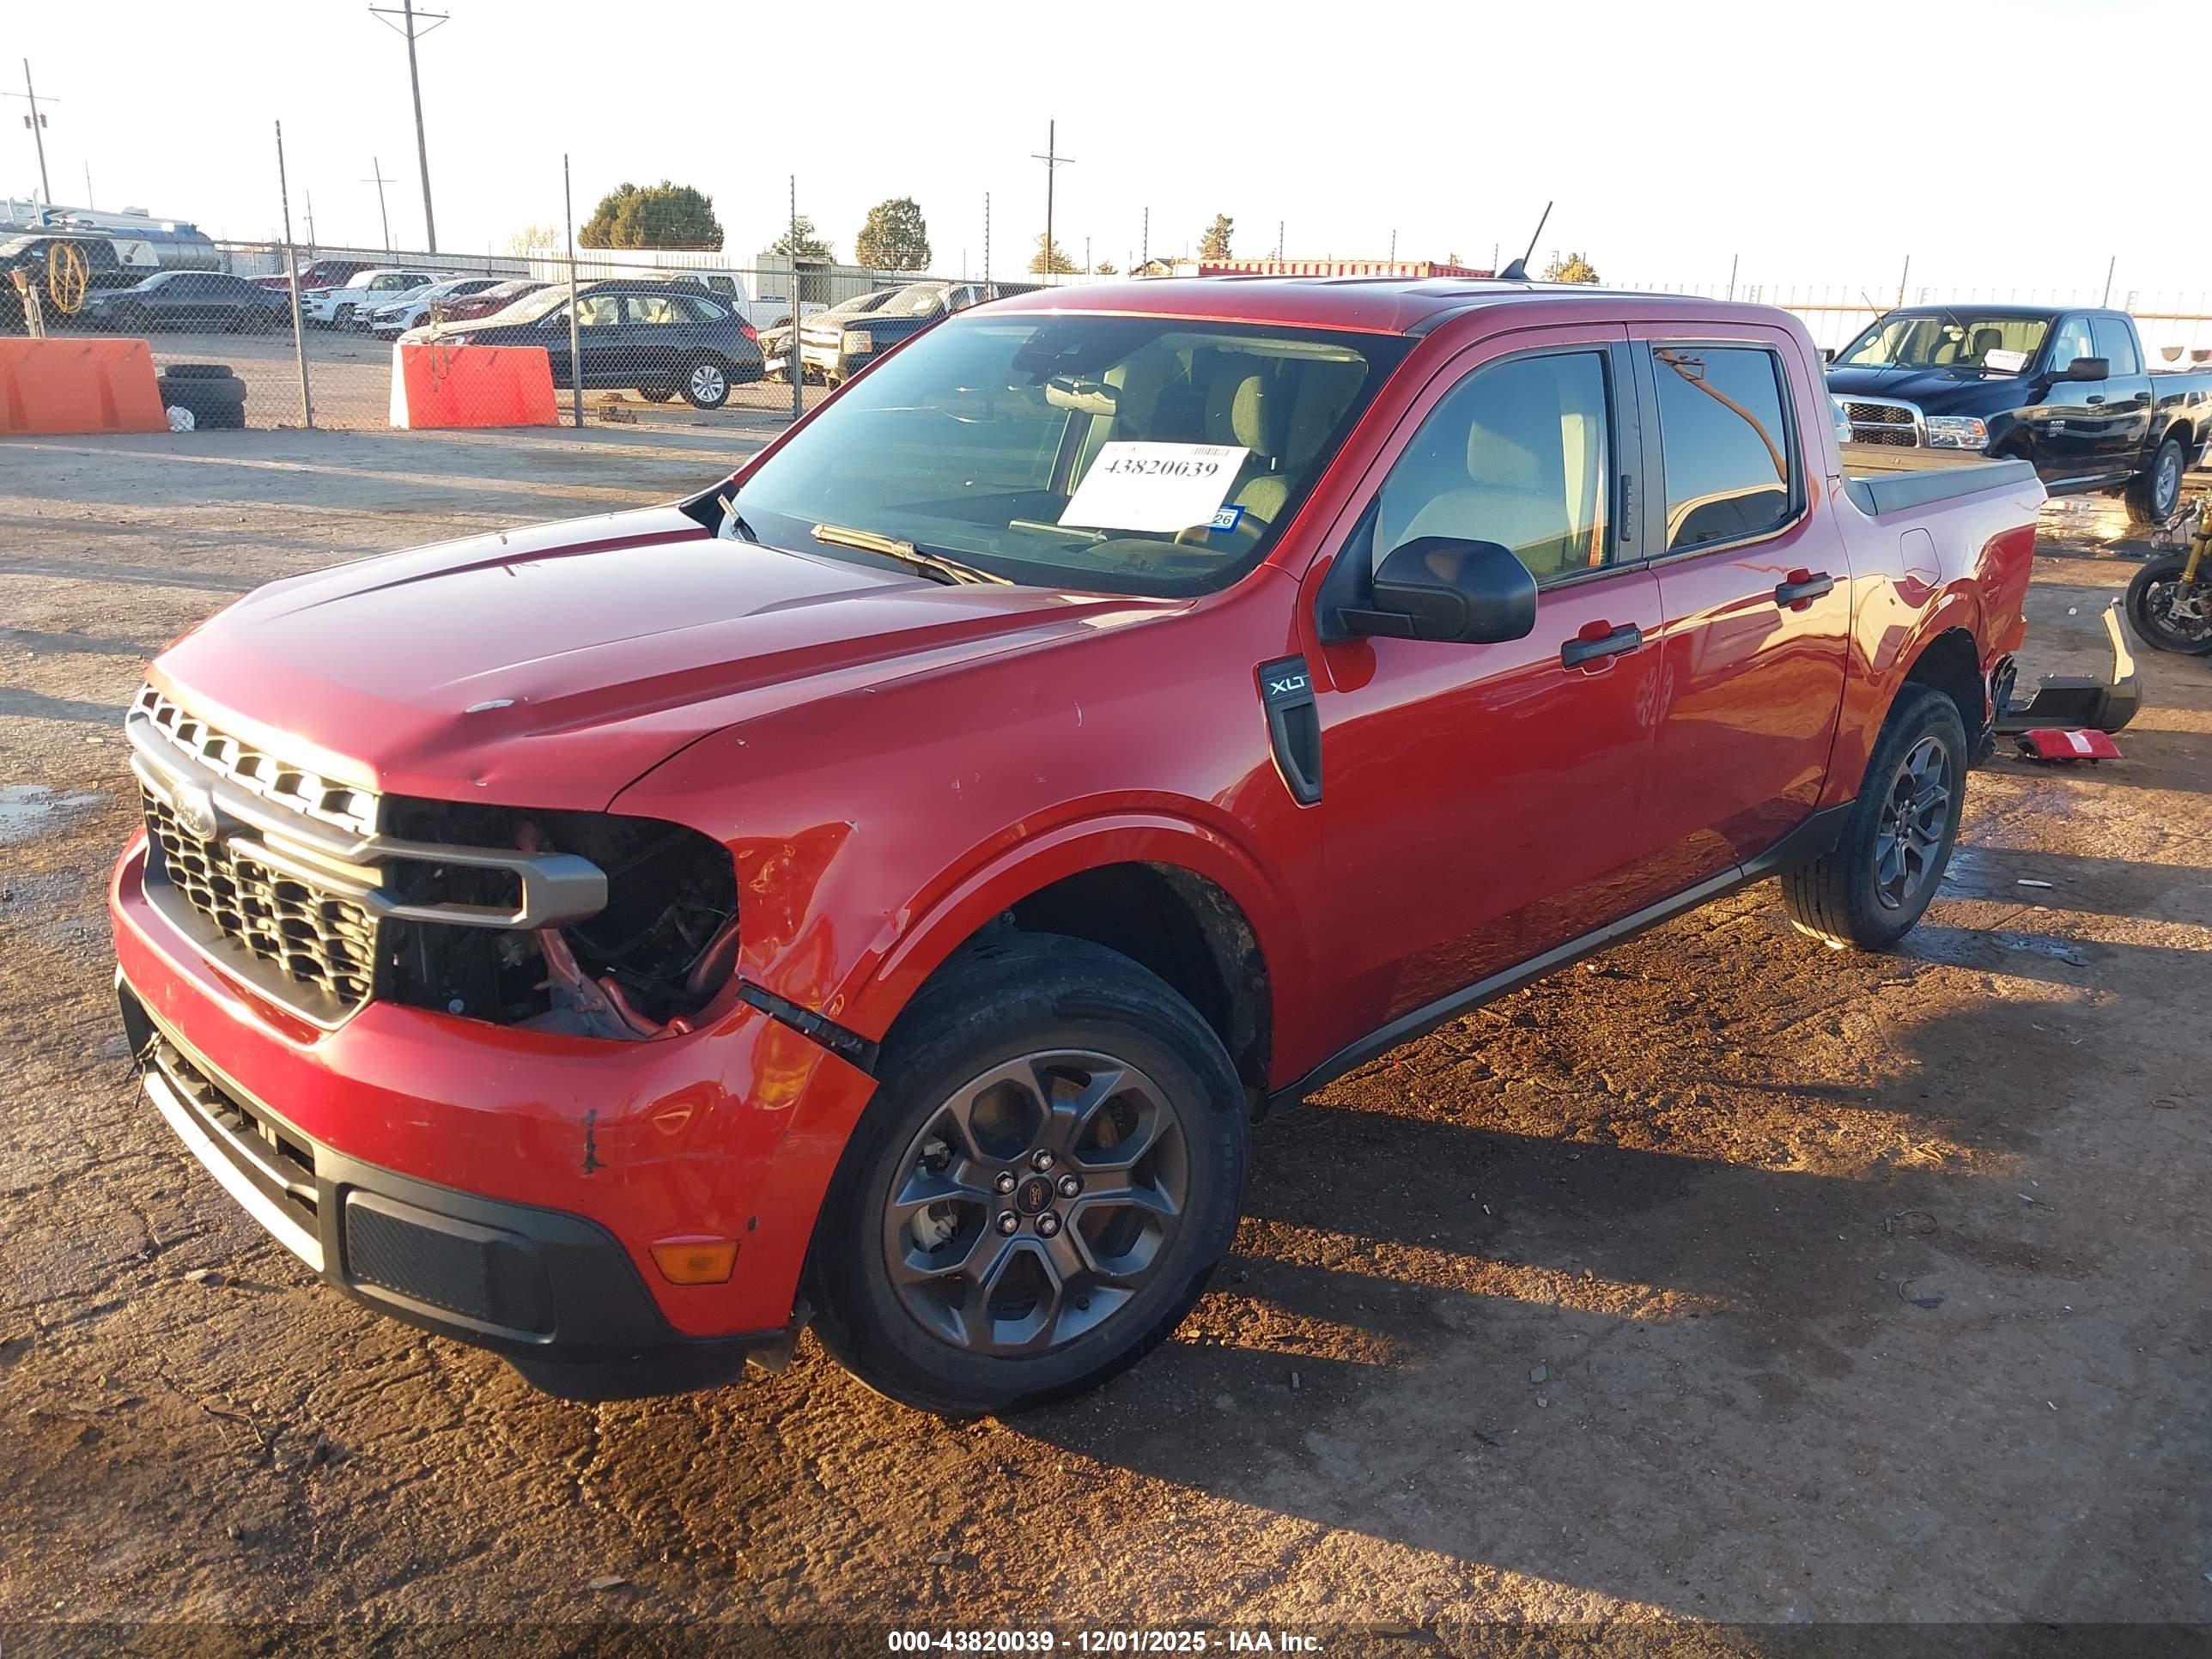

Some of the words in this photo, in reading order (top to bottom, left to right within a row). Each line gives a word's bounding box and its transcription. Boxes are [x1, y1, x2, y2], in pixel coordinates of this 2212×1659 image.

[1104, 458, 1219, 478] 43820039
[1212, 514, 1232, 525] 26
[1269, 676, 1305, 695] XLT
